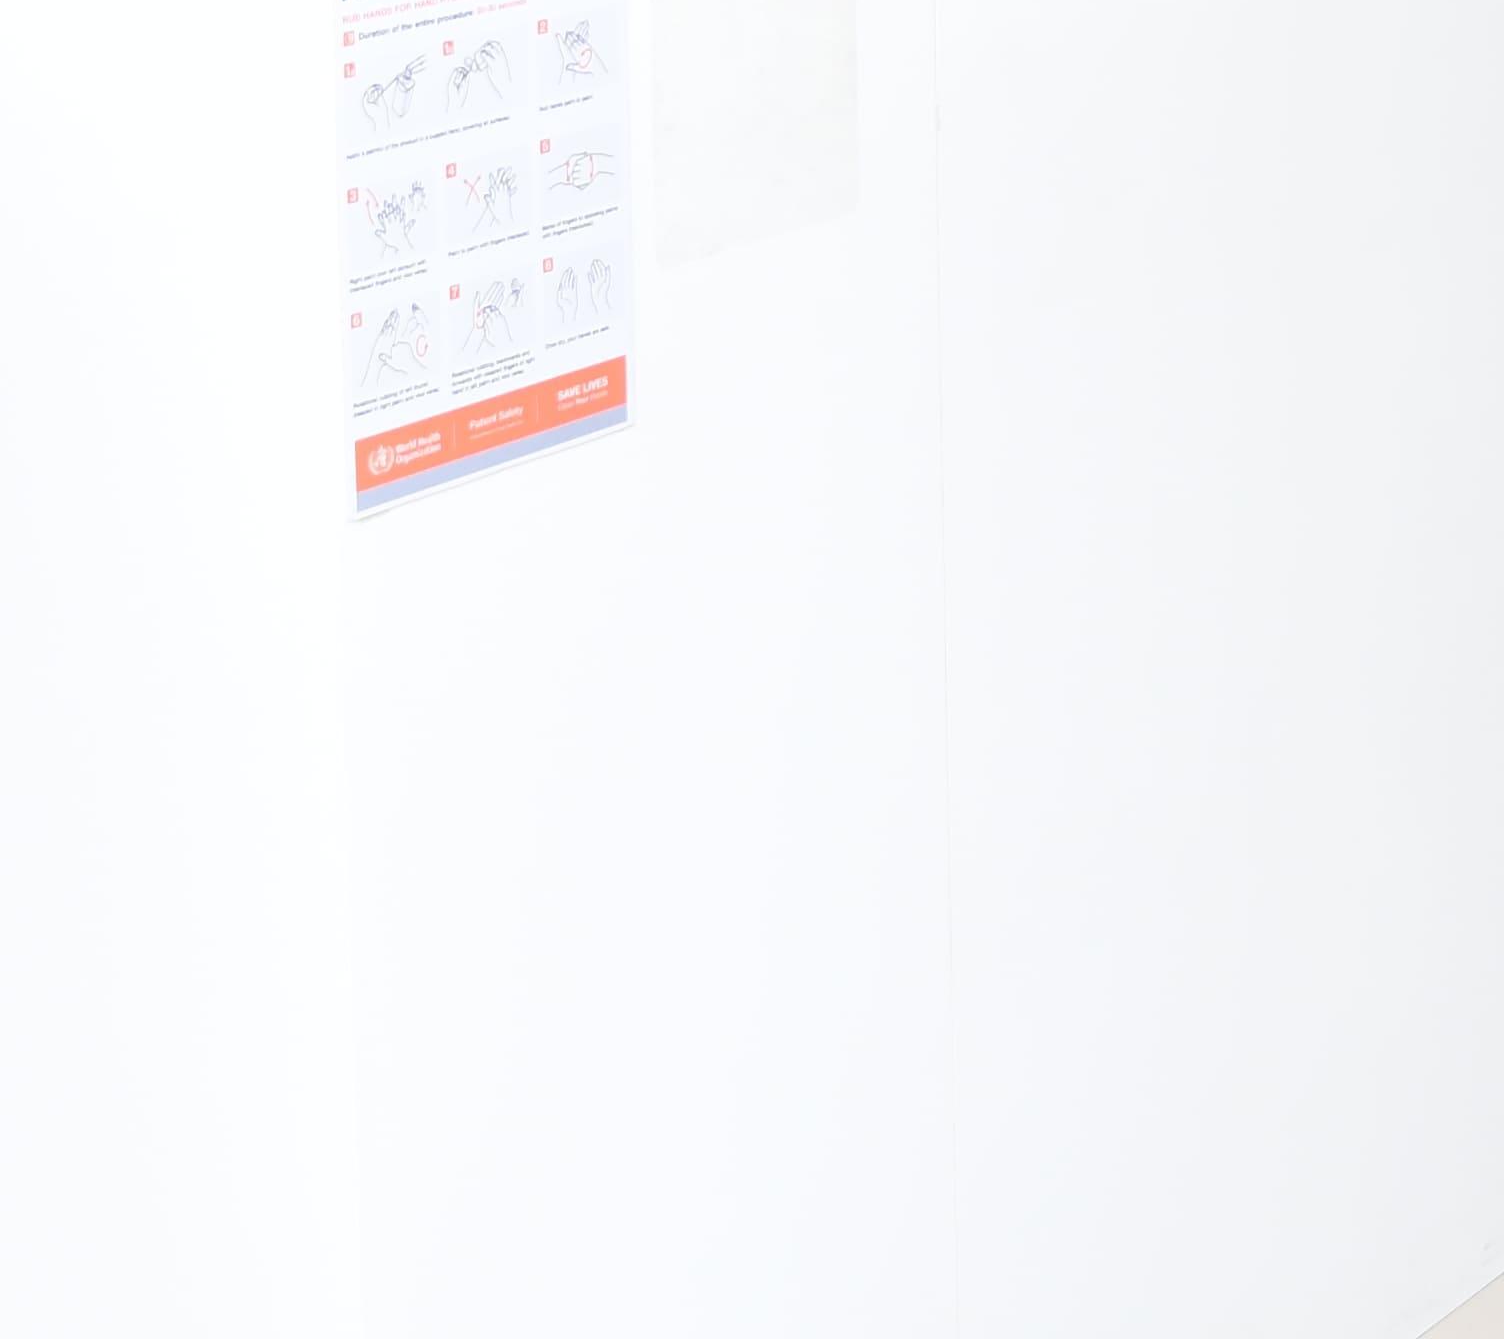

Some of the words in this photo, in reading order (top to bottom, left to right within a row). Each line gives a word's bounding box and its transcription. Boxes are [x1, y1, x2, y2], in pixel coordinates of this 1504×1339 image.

[358, 27, 390, 41] Duration
[401, 21, 413, 32] the
[415, 16, 435, 28] entire
[557, 384, 581, 400] SAVE
[583, 376, 608, 393] LIVES
[499, 405, 524, 421] Safety
